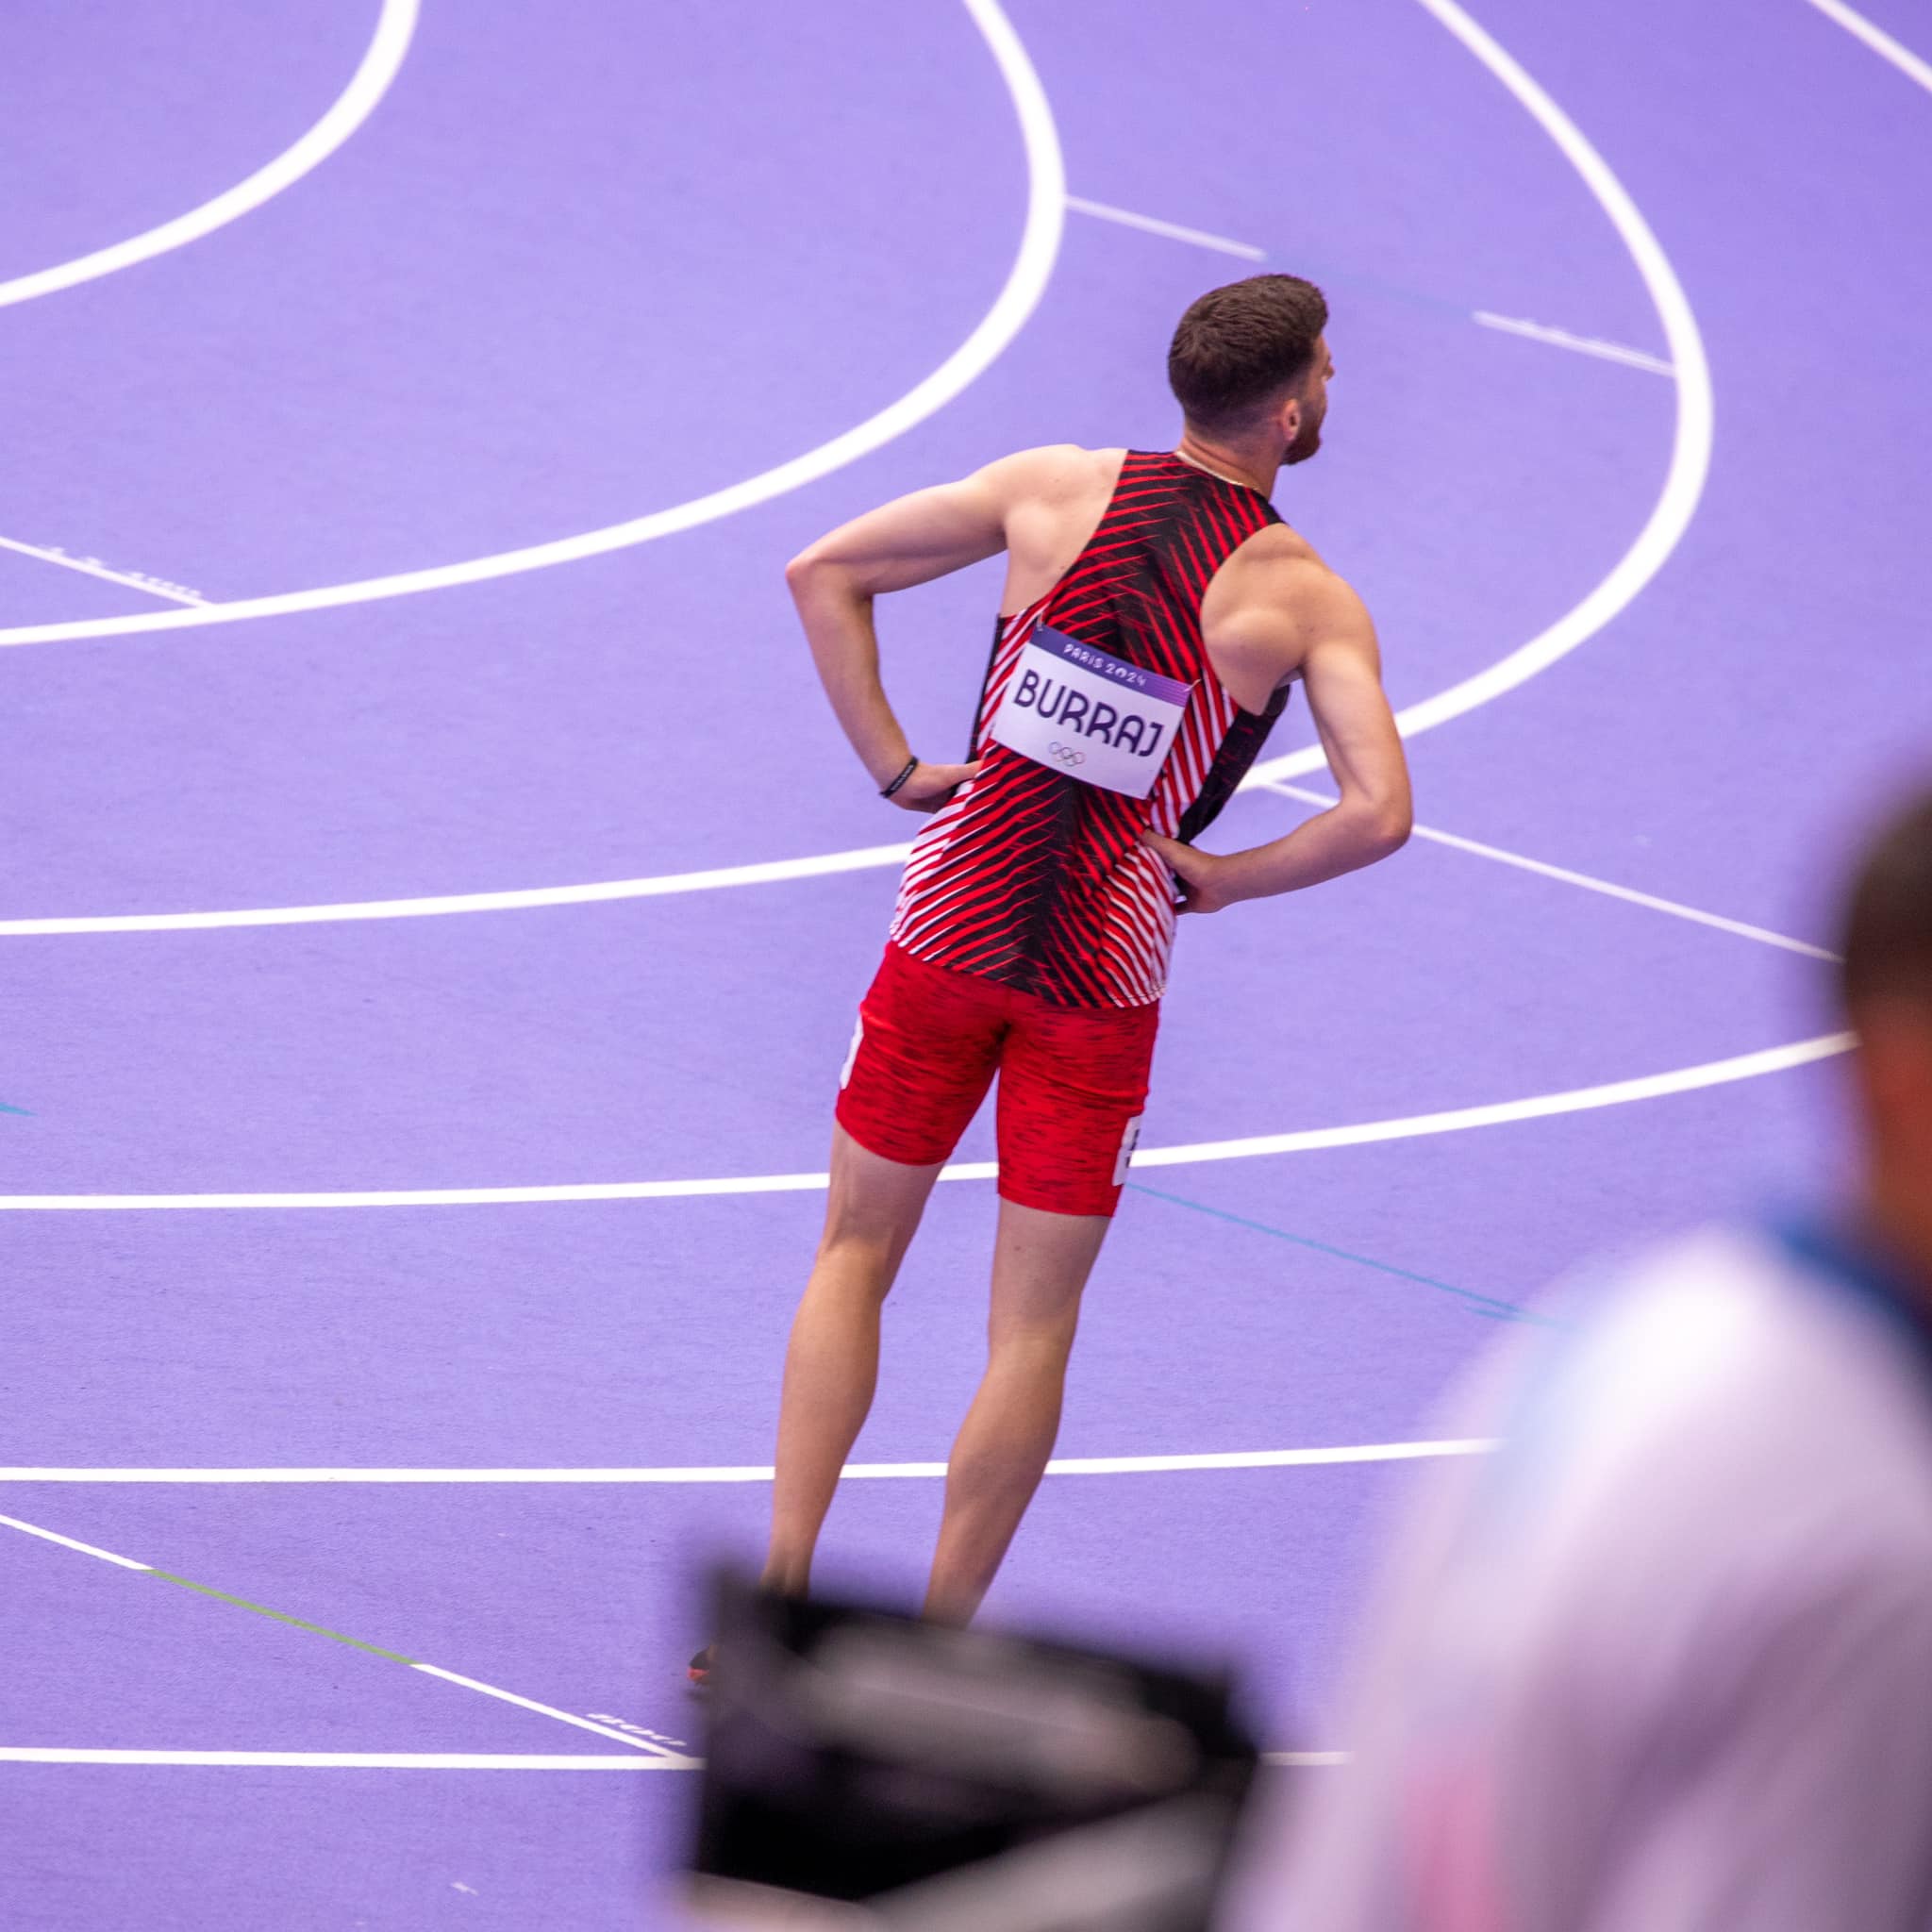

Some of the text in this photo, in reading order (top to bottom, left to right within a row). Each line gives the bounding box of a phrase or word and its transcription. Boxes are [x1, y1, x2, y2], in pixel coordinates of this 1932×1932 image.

[1063, 643, 1147, 687] PARIS 2024
[1013, 669, 1165, 758] BURRAJ
